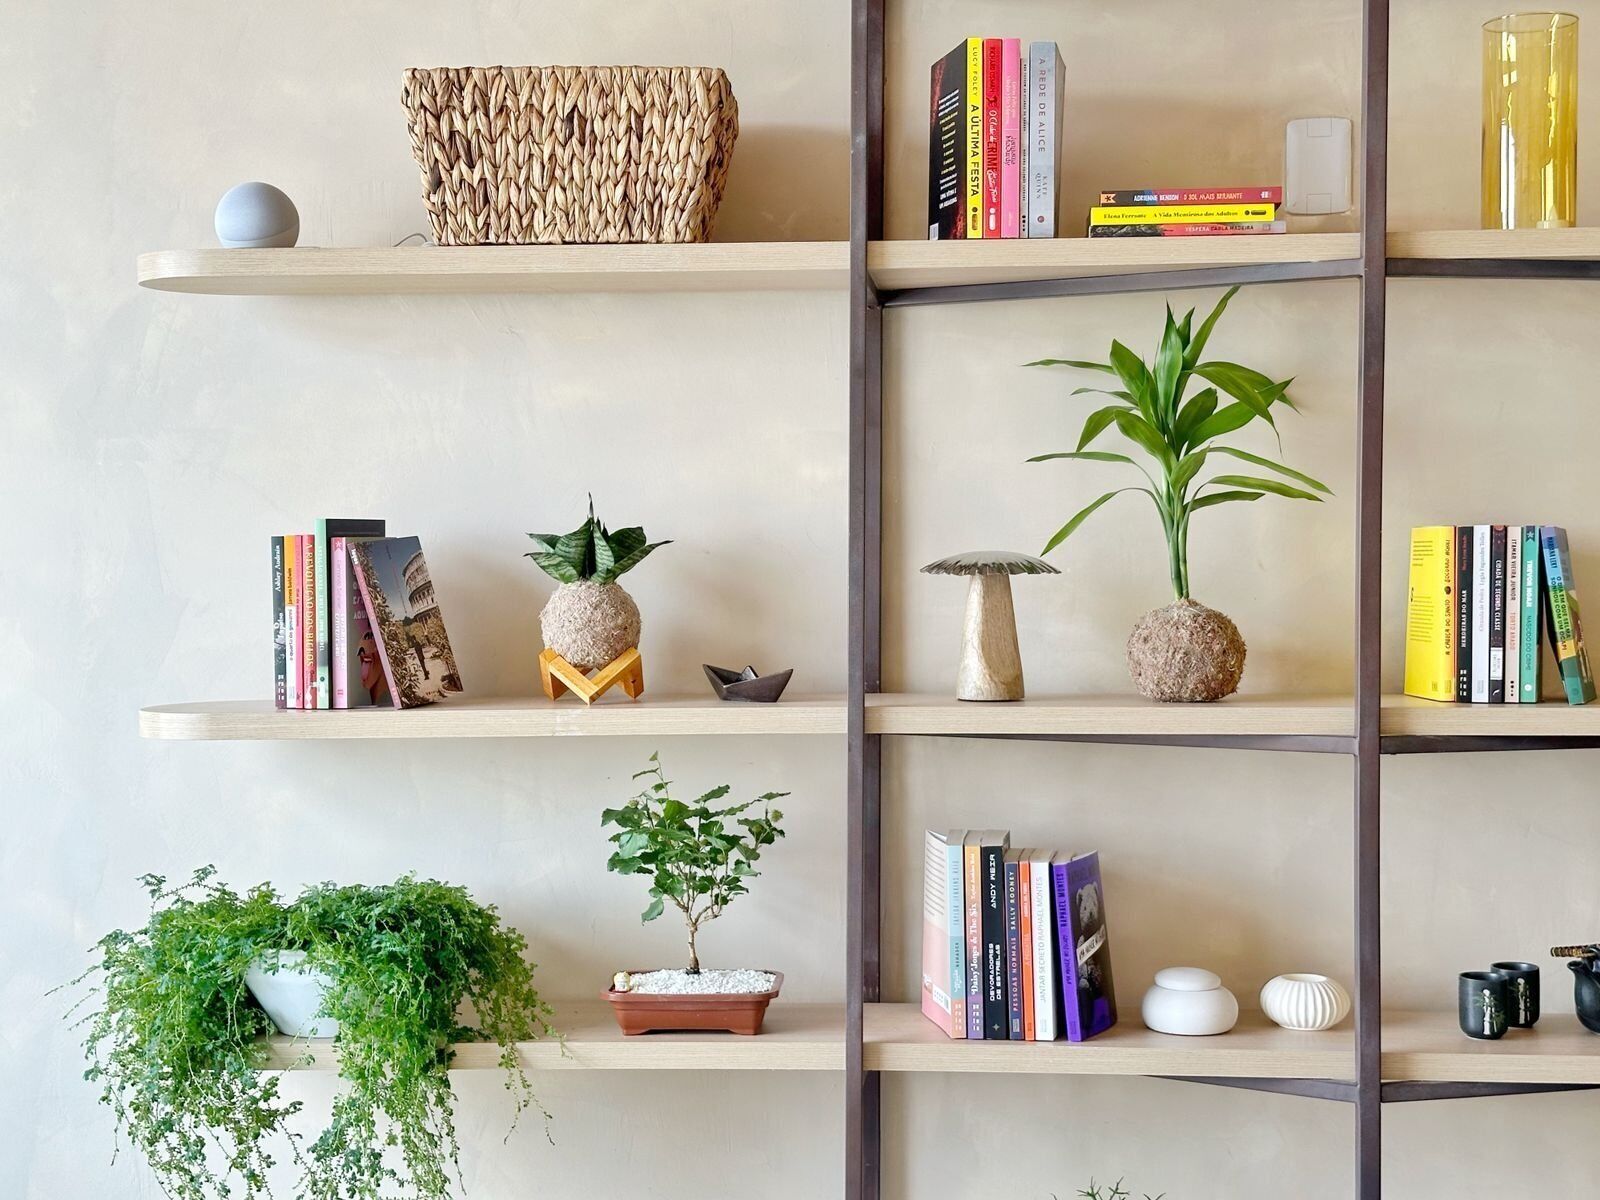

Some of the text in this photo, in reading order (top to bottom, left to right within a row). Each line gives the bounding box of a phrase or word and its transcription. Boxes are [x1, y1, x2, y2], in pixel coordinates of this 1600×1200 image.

[1038, 58, 1046, 153] A REDE DE ALICE
[970, 104, 982, 197] A ÚLTIMA FESTA
[986, 142, 998, 172] CRIME
[305, 543, 314, 551] A
[1495, 580, 1502, 588] DE
[1460, 603, 1467, 613] DO
[1560, 593, 1566, 604] EM
[304, 610, 314, 631] DOS
[1494, 611, 1502, 631] CLASSE
[1561, 604, 1569, 617] QUE
[1557, 620, 1563, 630] UM
[1563, 617, 1571, 638] SELMA
[1525, 643, 1531, 653] DO
[1559, 631, 1568, 651] OCAPI
[989, 883, 997, 909] ANDY
[1056, 873, 1068, 928] RAPHAEL MONTES
[969, 918, 978, 936] The
[1035, 876, 1047, 1002] JANTAR SECRETO RAPHAEL MONTES
[988, 943, 996, 1002] DEVORADORES
[994, 944, 1002, 1001] DE ESTRELAS
[1011, 977, 1019, 1012] PESSOAS
